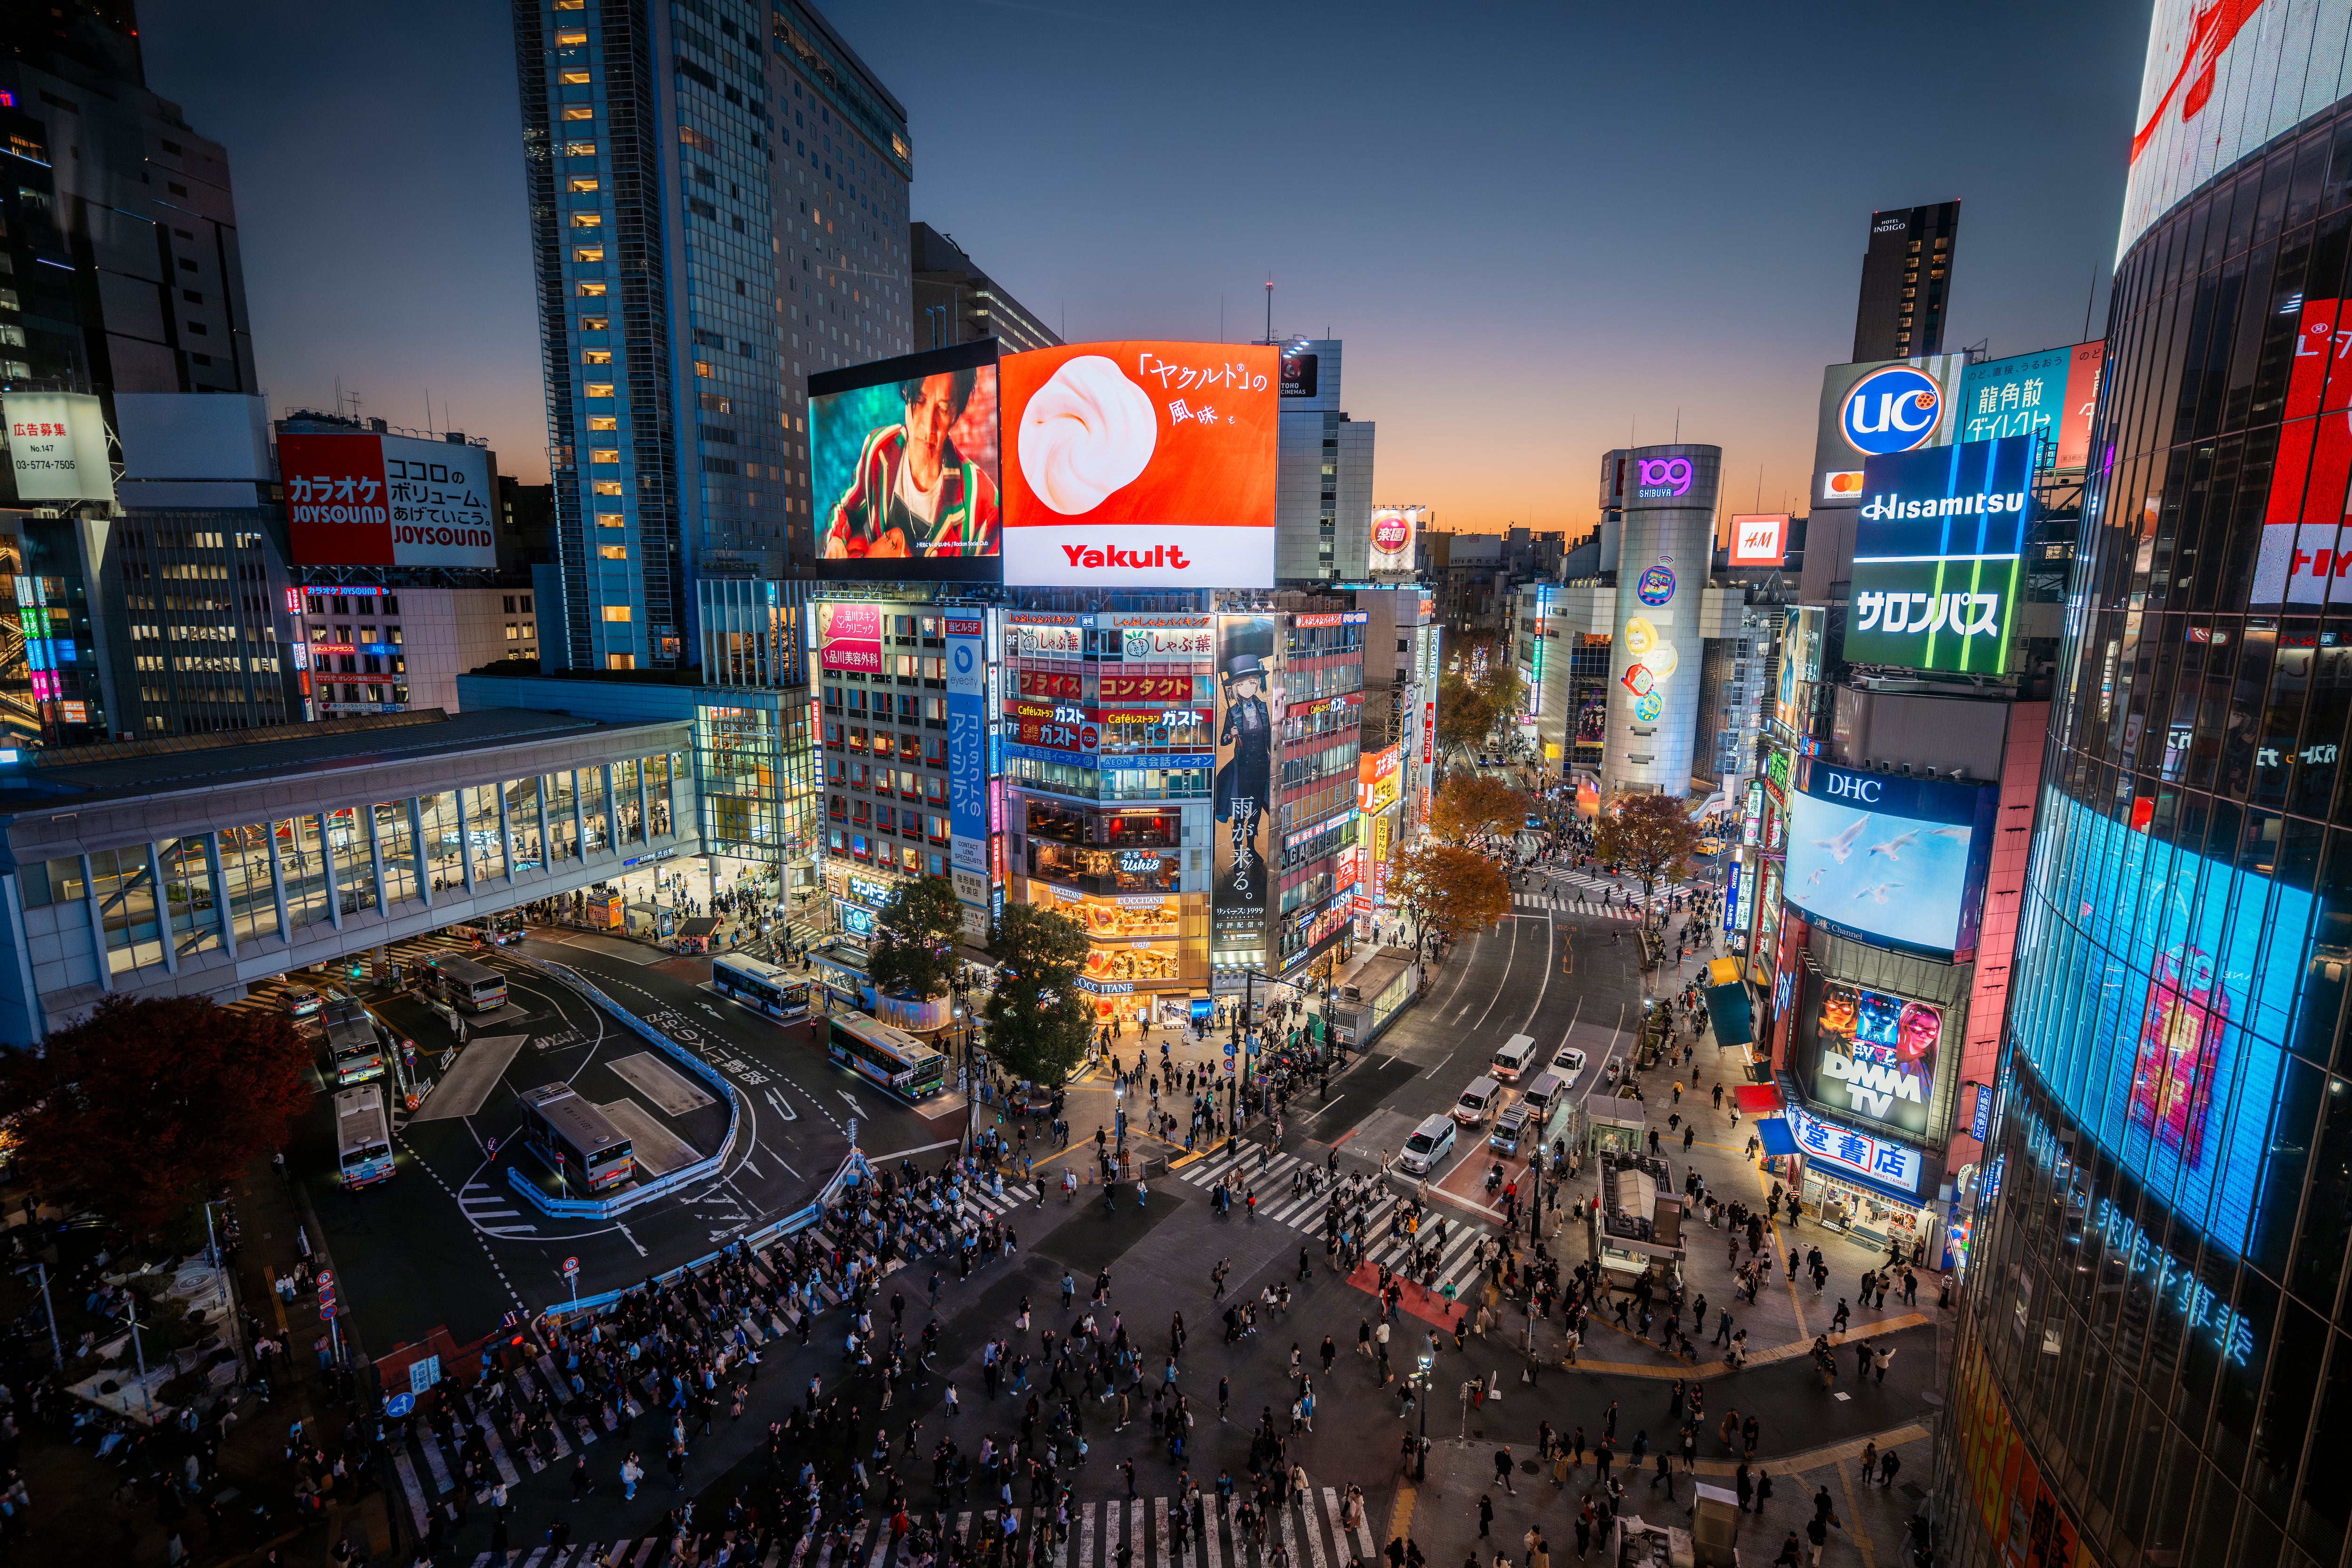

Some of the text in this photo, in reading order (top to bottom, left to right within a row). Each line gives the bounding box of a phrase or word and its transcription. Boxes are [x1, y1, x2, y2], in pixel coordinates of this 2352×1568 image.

[1874, 223, 1905, 233] INDIGO
[1968, 357, 2062, 381] のど、直接、うるおう
[1979, 378, 2043, 414] 龍角散
[14, 423, 66, 437] 広告募集
[16, 460, 75, 470] 03-5774-7505
[388, 459, 464, 485] ココロの
[1638, 458, 1693, 497] 109
[290, 475, 381, 503] カラオケ
[392, 483, 487, 509] ボリューム、
[1639, 488, 1671, 498] SHIBUYA
[294, 506, 386, 524] JOYSOUND
[1861, 493, 2024, 520] Hisamitsu
[394, 507, 490, 526] あげていこう。
[394, 525, 492, 547] JOYSOUND
[1377, 527, 1406, 541] 楽園
[1745, 531, 1773, 550] H&M
[1061, 544, 1191, 569] Yakult
[1371, 540, 1409, 555] EXCITING AMUSEMENT
[845, 611, 877, 622] 品川スキン
[1009, 613, 1094, 626] しゃぶしゃぶバイキング 寿司
[1113, 616, 1211, 628] しゃぶしゃぶバイキング
[1301, 614, 1342, 627] しゃぶしゃぶバイキング
[1857, 592, 1998, 637] サロンパス
[845, 623, 874, 634] クリニック
[948, 621, 978, 633] 当ビル5F
[1007, 634, 1017, 646] 9F
[1040, 633, 1078, 651] しゃぶ葉
[1154, 635, 1211, 653] しゃぶ葉
[829, 650, 879, 667] 品川美容外科
[1429, 644, 1438, 679] CAMERA
[950, 676, 978, 689] eyecity
[1021, 674, 1080, 694] プライス
[1100, 679, 1190, 696] コンタクト
[1310, 697, 1346, 715] Caféレストラン ガスト
[1405, 690, 1413, 710] OS
[1018, 705, 1085, 724] Caféレストラン ガスト
[1108, 710, 1203, 726] Caféレストラン ガスト
[1427, 709, 1433, 721] 免税
[702, 722, 740, 731] MARK
[1007, 722, 1019, 734] 7F
[1023, 724, 1038, 733] Café
[1040, 725, 1076, 747] ガスト
[1083, 735, 1097, 743] ガスト
[952, 713, 968, 814] アイシティ
[1006, 745, 1081, 764] AEON 英会話イーオン
[1104, 756, 1212, 767] AEON 英会話イーオン
[1375, 750, 1398, 777] スギ薬局
[814, 750, 823, 784] 加藤眼科
[968, 715, 981, 817] コンタクトの
[1374, 778, 1396, 808] 処方せん
[1827, 772, 1881, 803] DHC
[818, 811, 825, 822] 内科
[1289, 807, 1359, 846] 薄毛 抜毛 発毛 4F
[958, 841, 978, 850] CONTACT
[1231, 796, 1255, 899] 雨が来る。
[639, 853, 655, 862] 井の頭線
[657, 848, 674, 858] 渋谷駅
[955, 853, 982, 865] SPECIALISTS
[1281, 845, 1305, 868] AGA
[957, 874, 982, 888] 隐形眼镜
[960, 885, 978, 897] 专卖店
[1049, 885, 1083, 899] L'OCCITANE
[1117, 896, 1165, 905] L'OCCITANE
[1331, 889, 1351, 912] LUSH
[1216, 921, 1264, 929] 好評配信中
[1299, 912, 1313, 924] サンドラッグ
[1815, 917, 1863, 940] DHC Channel
[1288, 947, 1308, 965] サンドラッグ
[847, 1016, 867, 1025] E400
[1822, 1050, 1921, 1104] DMM
[1846, 1083, 1893, 1118] TV
[1974, 1089, 1989, 1140] 大盛堂商事ビル
[1849, 1180, 1879, 1193] TAISEIDO
[1874, 1172, 1910, 1188] BOOKS TAISEIDO
